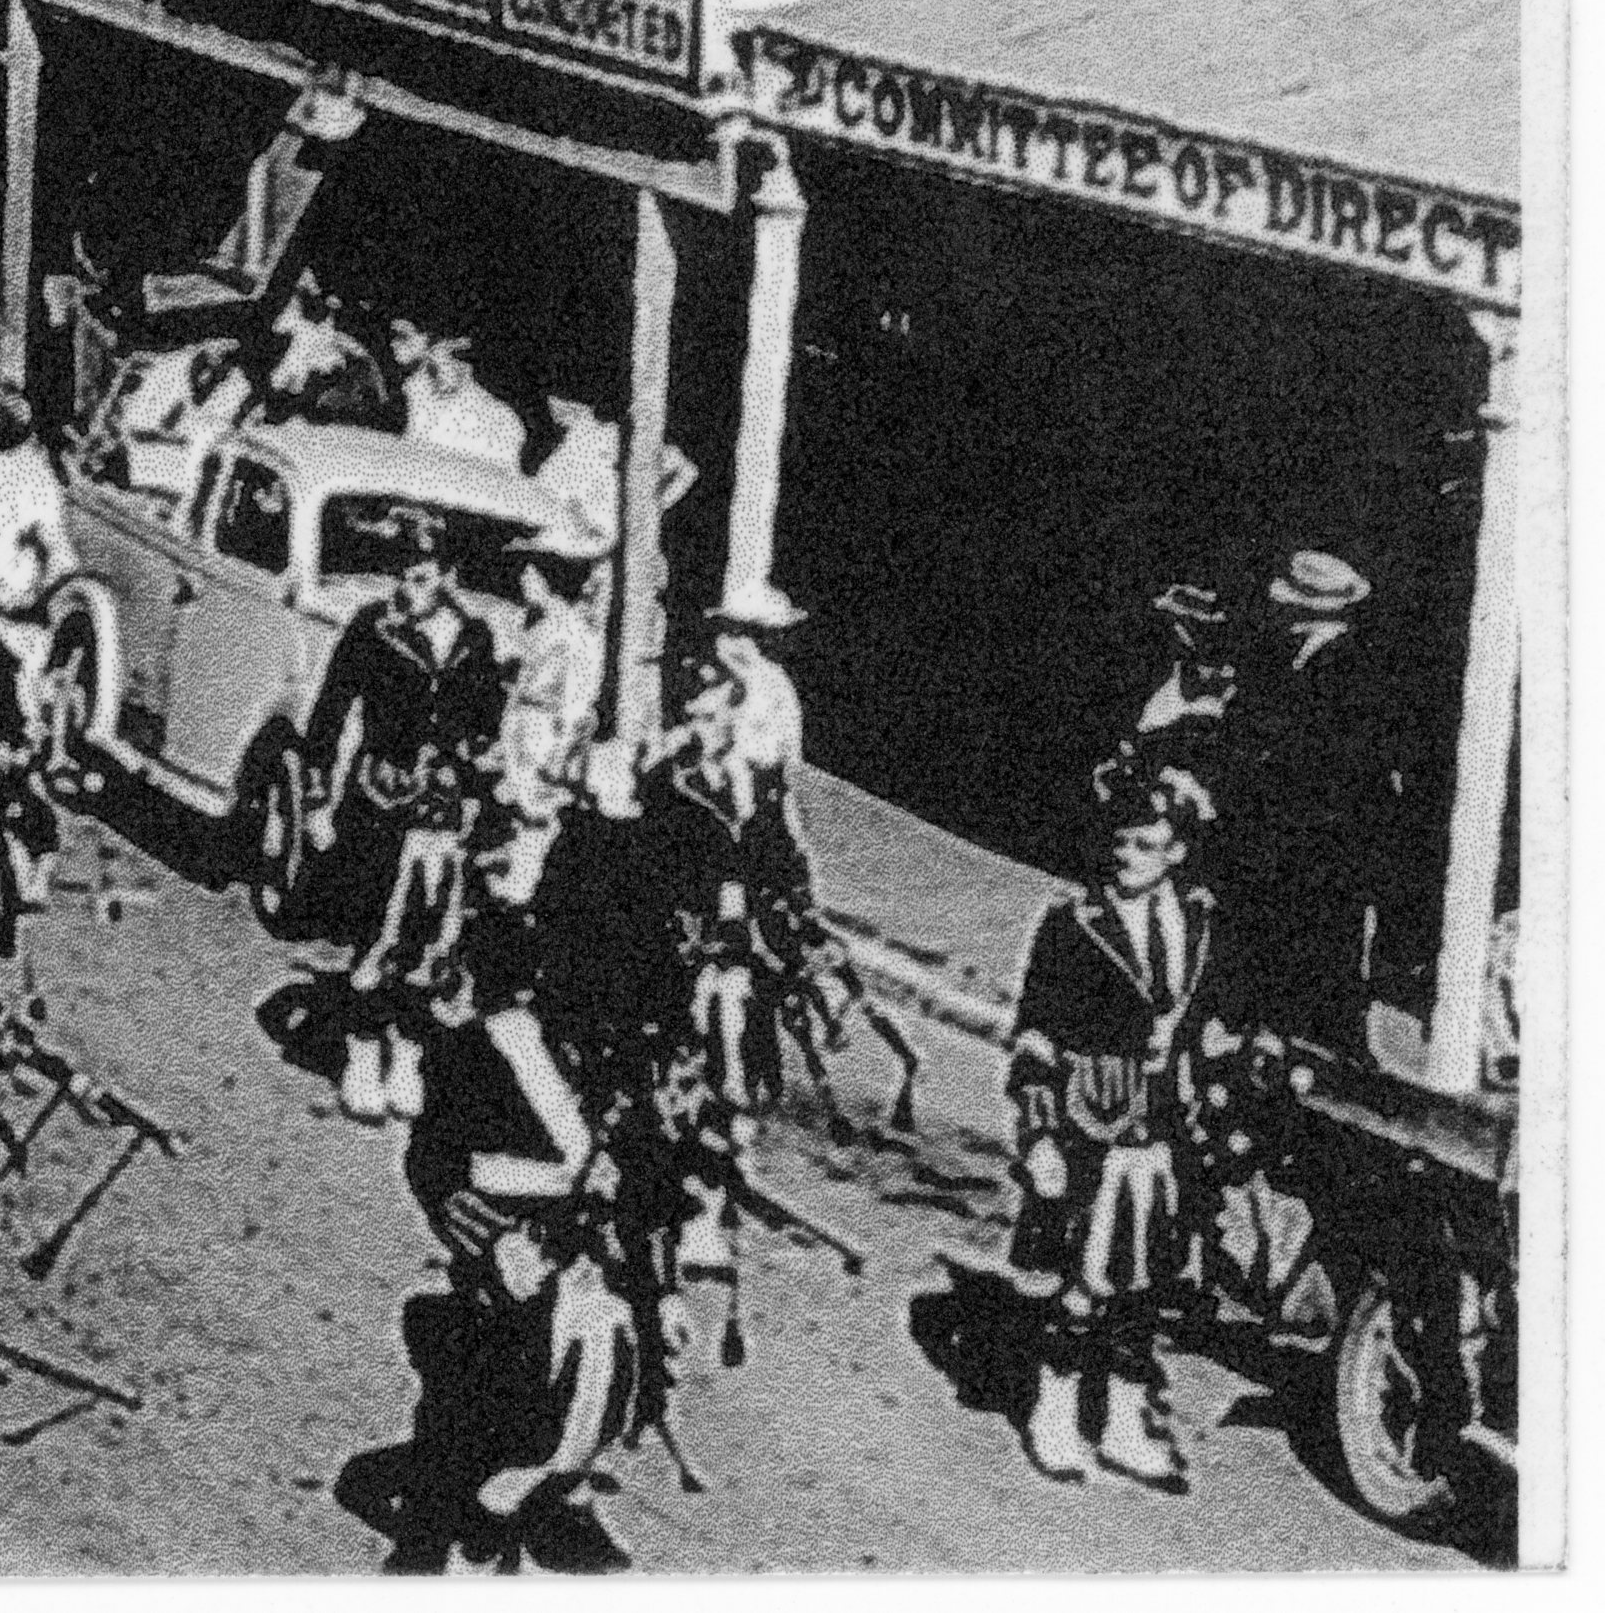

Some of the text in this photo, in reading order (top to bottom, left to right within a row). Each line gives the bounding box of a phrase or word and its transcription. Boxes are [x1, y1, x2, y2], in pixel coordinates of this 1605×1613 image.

[836, 55, 1160, 199] COMMITTEE
[1172, 143, 1257, 219] OF
[1262, 155, 1520, 287] DIRECT
